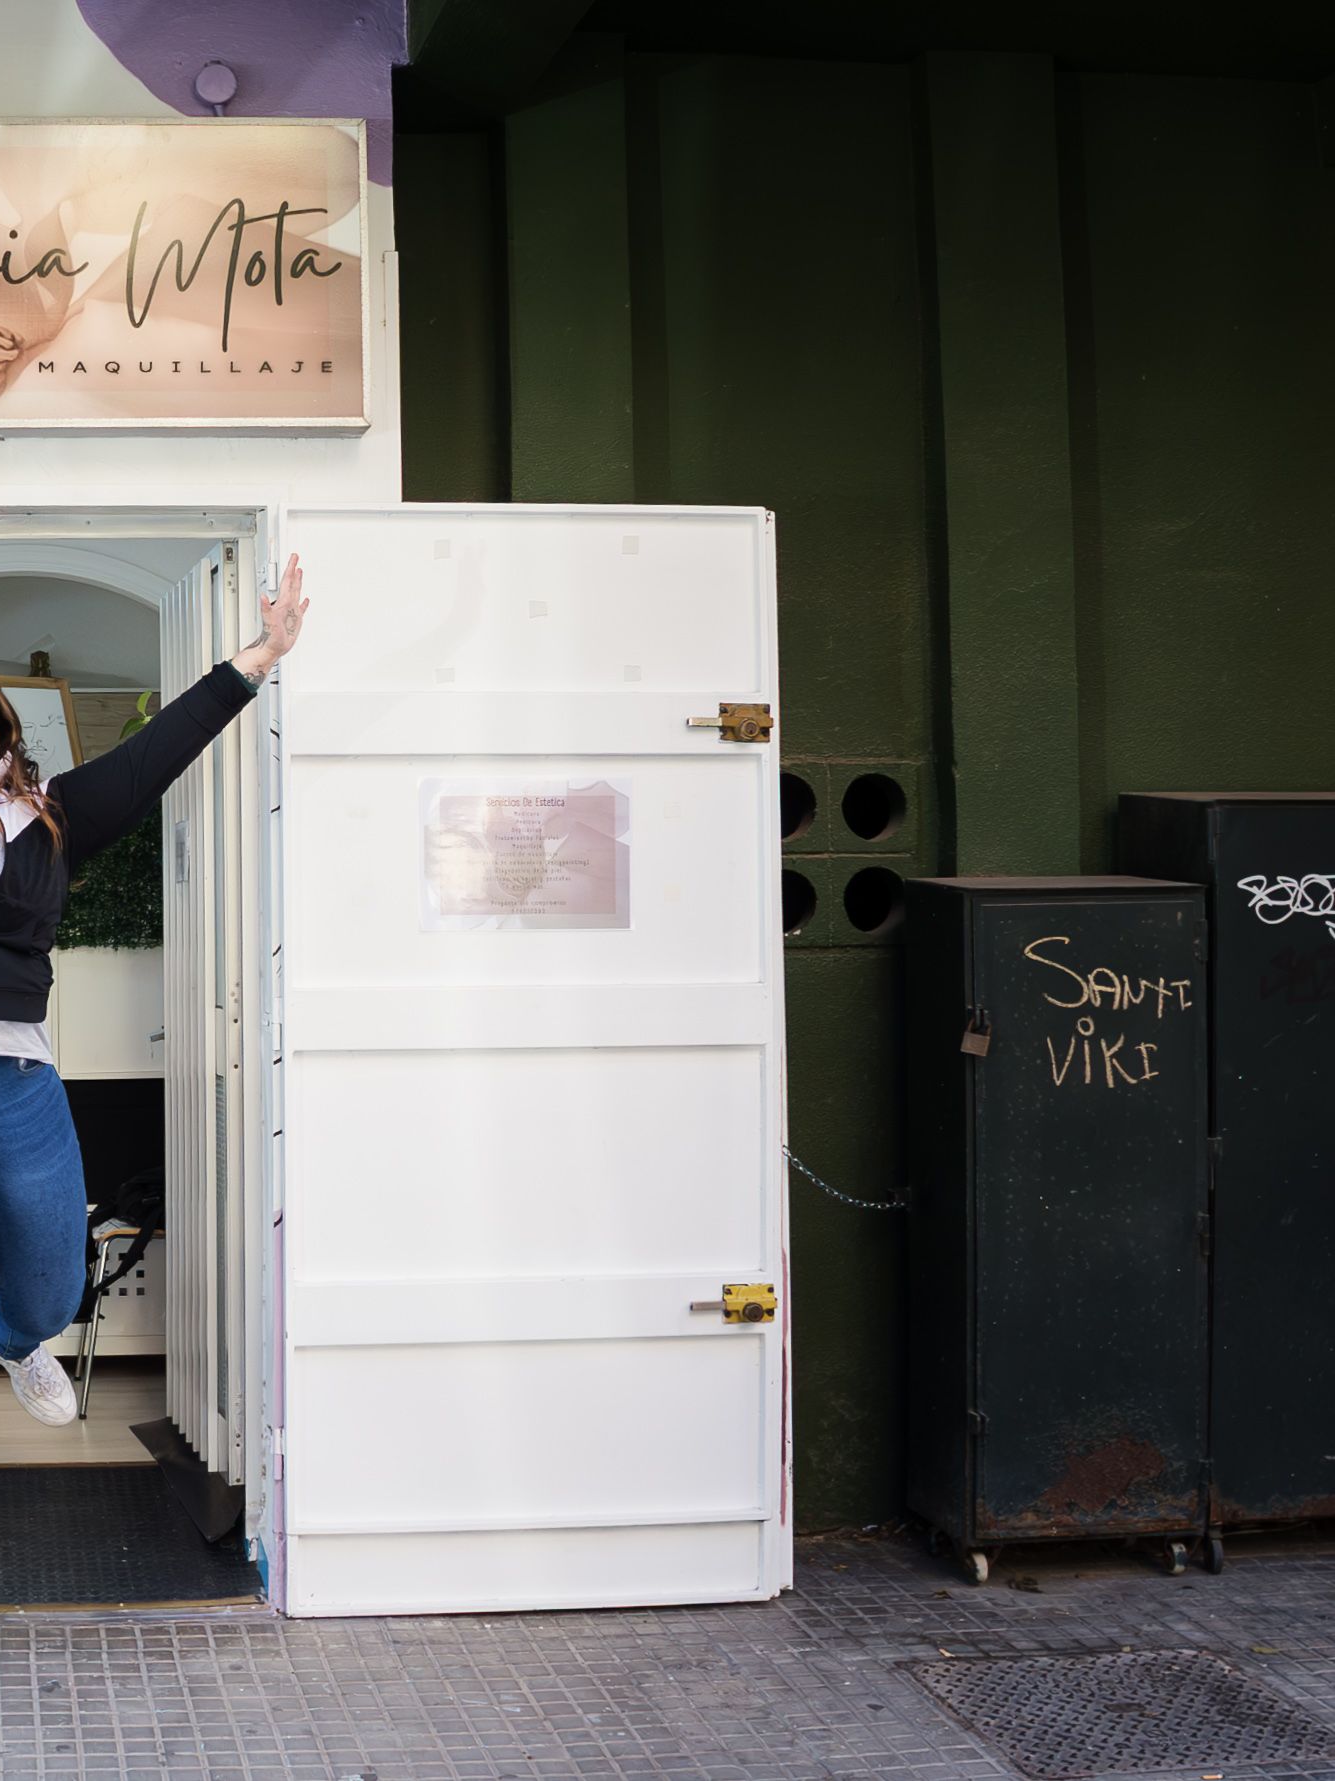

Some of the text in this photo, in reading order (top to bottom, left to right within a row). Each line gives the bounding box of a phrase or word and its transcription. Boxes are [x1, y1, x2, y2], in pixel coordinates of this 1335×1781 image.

[125, 198, 342, 352] Mota
[38, 360, 334, 375] MAQUILLAJE
[486, 797, 520, 807] Servicios
[522, 797, 533, 807] De
